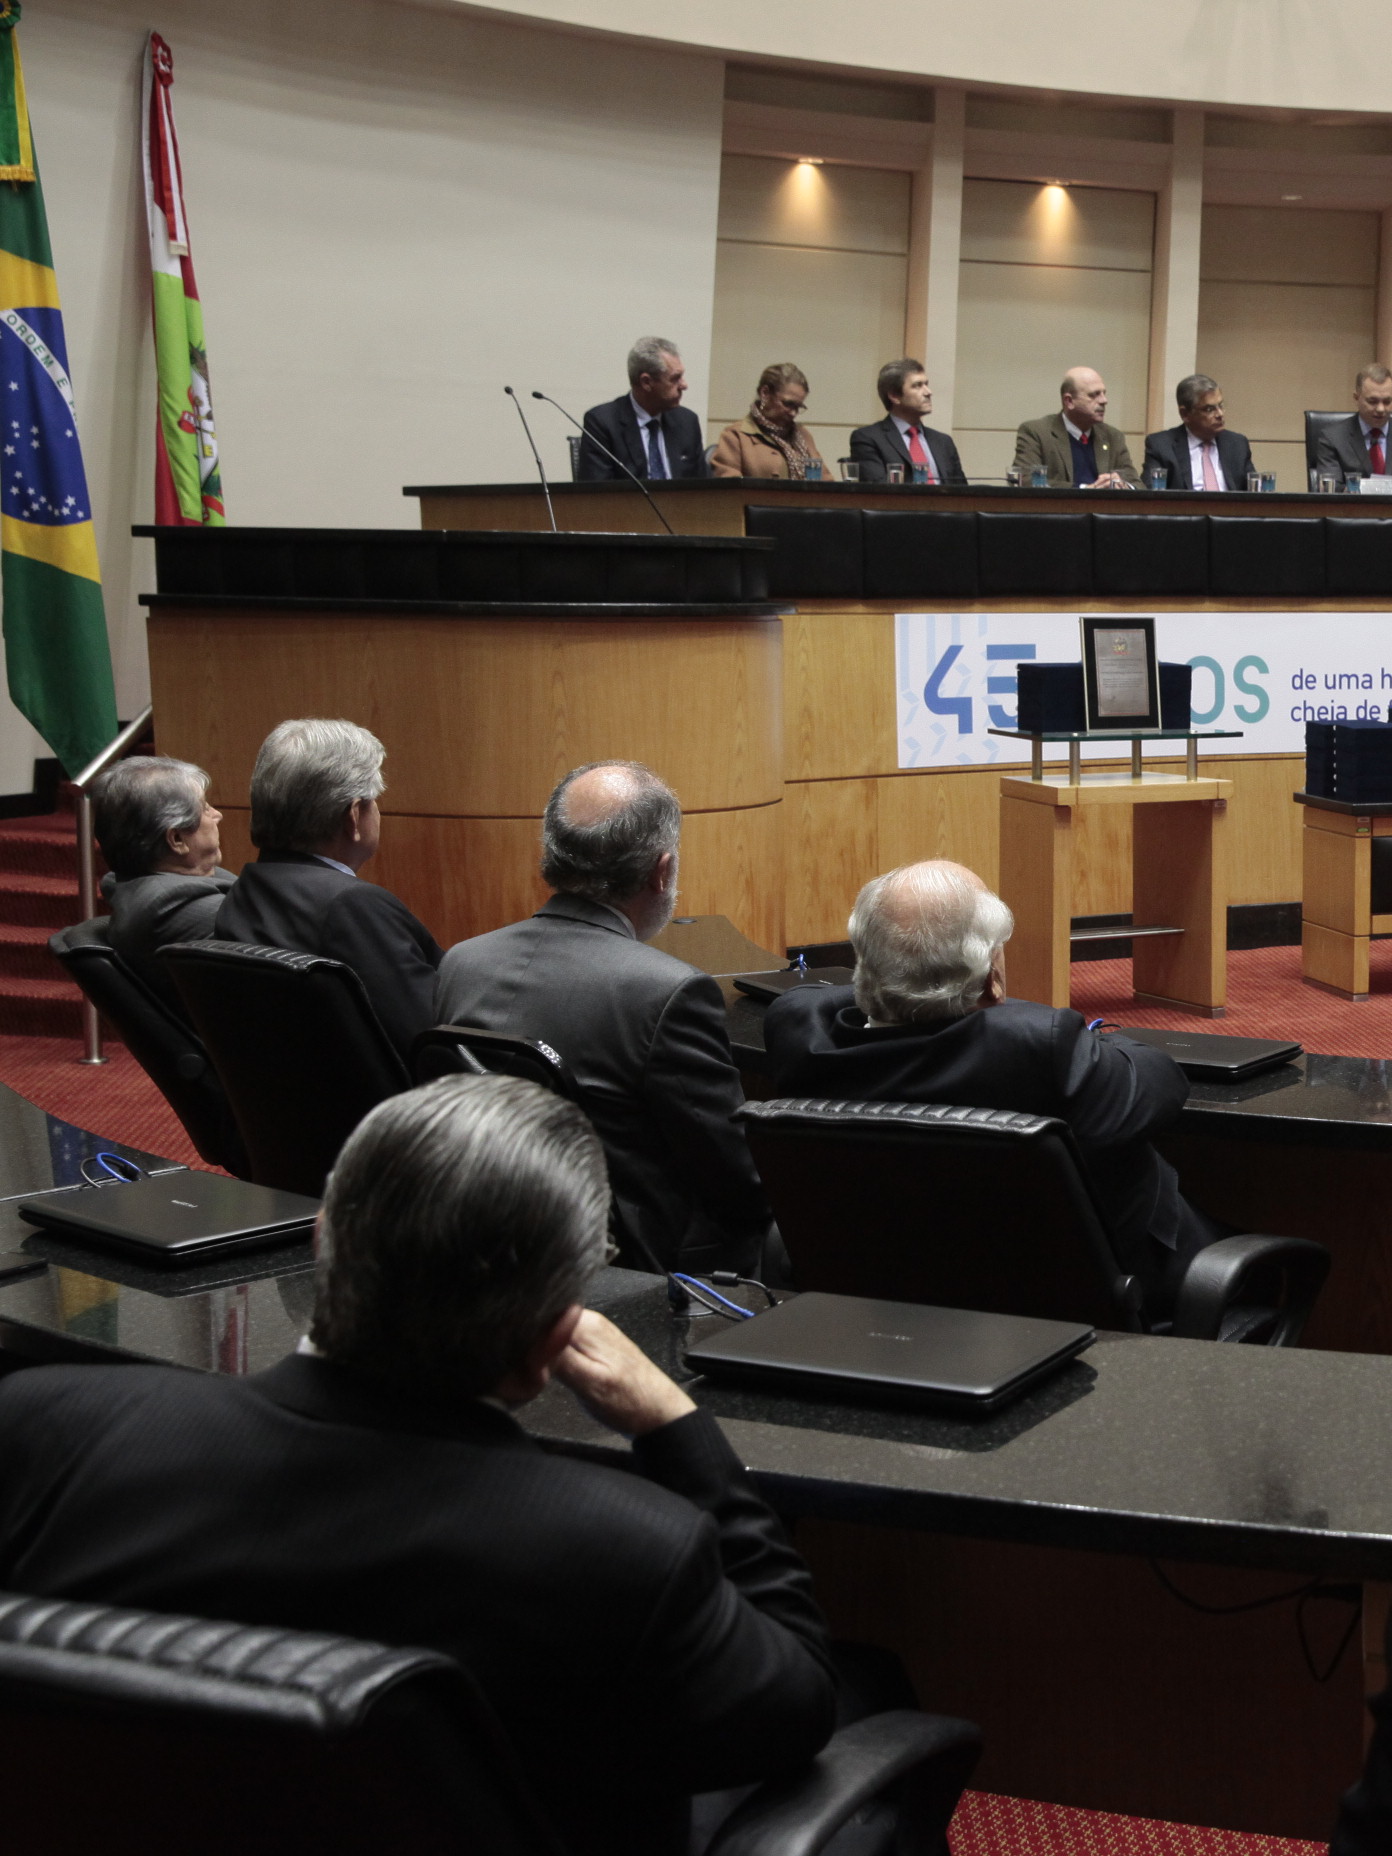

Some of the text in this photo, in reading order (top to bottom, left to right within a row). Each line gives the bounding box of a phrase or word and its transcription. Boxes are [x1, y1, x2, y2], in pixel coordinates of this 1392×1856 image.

[6, 314, 68, 389] ORDEM E
[1291, 668, 1317, 690] de
[1324, 674, 1373, 690] uma
[1290, 700, 1348, 722] cheia
[1355, 699, 1381, 721] de
